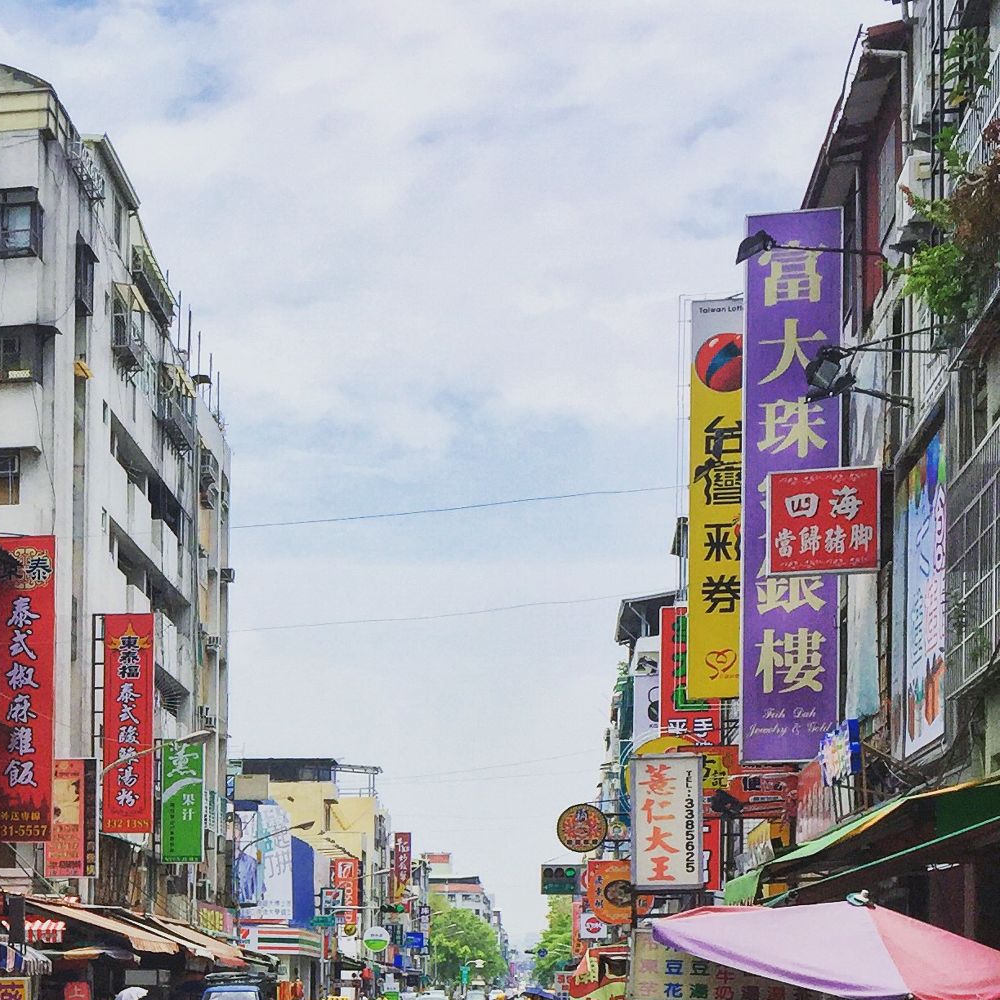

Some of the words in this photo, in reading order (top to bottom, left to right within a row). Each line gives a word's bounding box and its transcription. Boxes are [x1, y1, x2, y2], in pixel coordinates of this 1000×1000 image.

[699, 306, 727, 314] Taiwan
[728, 305, 744, 313] Lott
[755, 240, 827, 695] 富大珠銀樓
[785, 486, 862, 521] 四海
[4, 596, 41, 788] 泰式椒麻雞飯
[182, 793, 196, 821] 果汁
[638, 764, 680, 882] 薏仁大王
